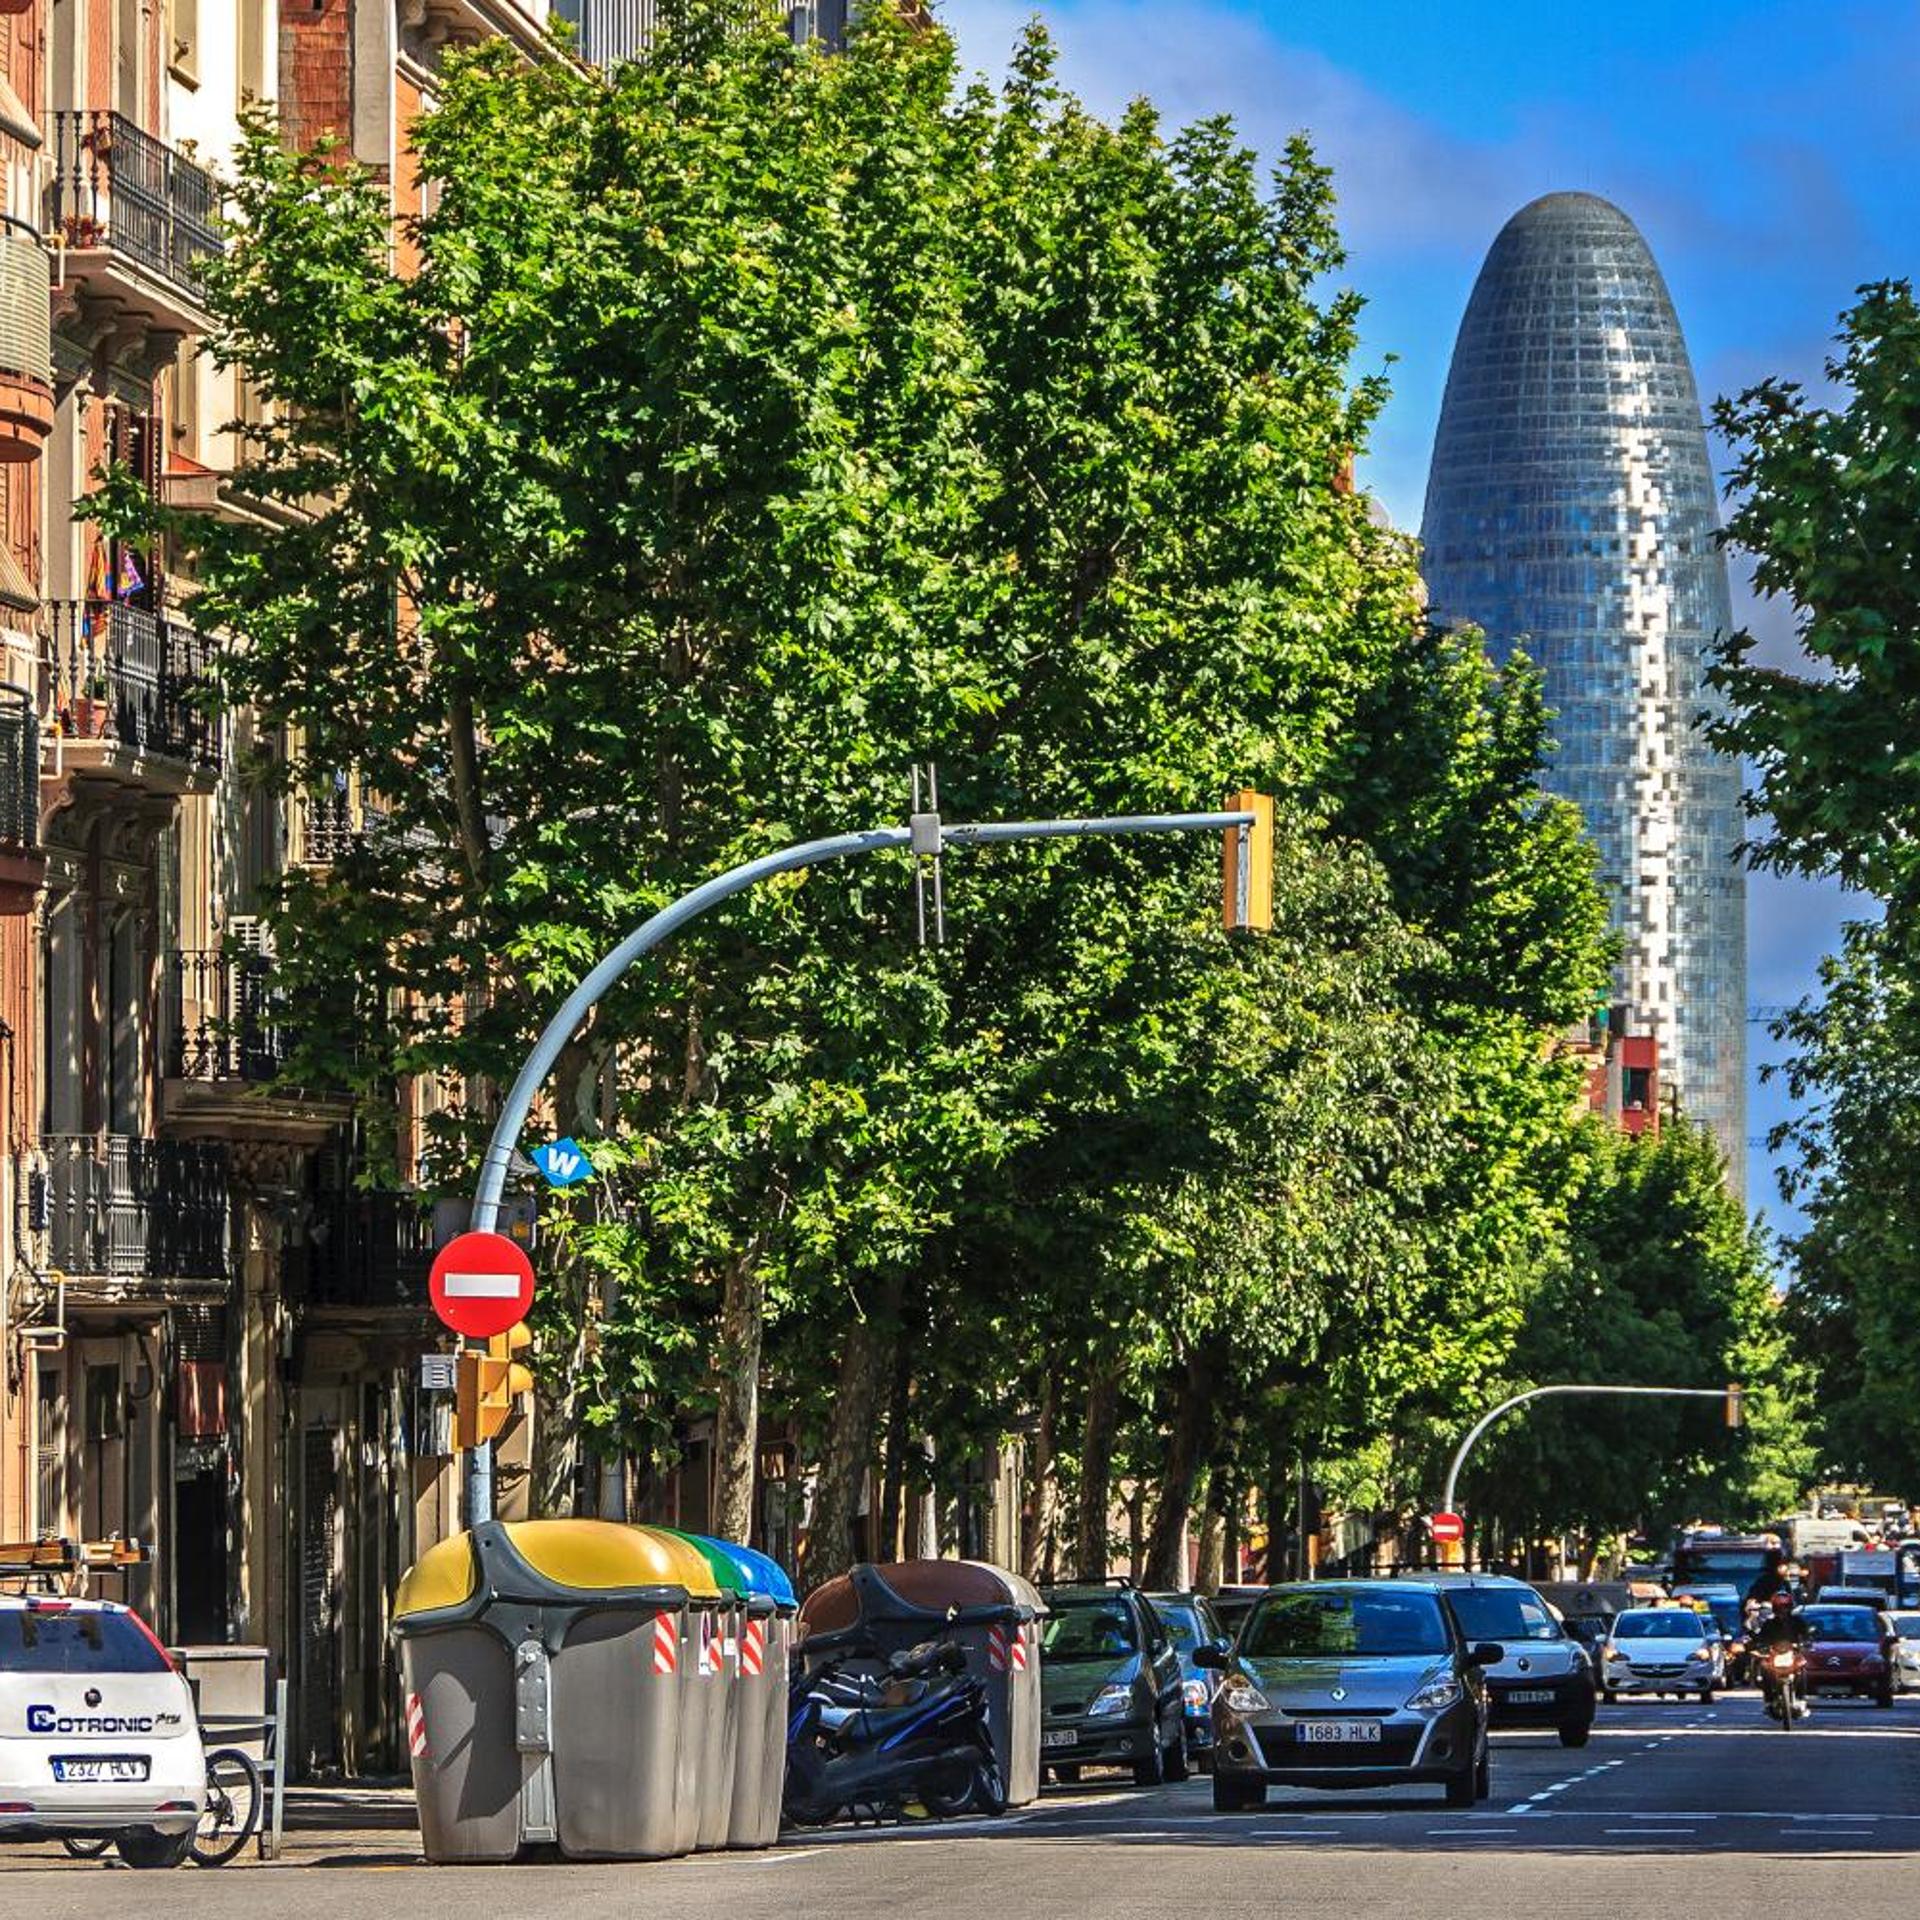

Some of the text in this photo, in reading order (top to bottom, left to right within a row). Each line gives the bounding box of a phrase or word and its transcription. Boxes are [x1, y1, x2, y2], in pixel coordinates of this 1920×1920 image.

[548, 1147, 580, 1177] W
[1309, 1725, 1377, 1740] 1683 HLK
